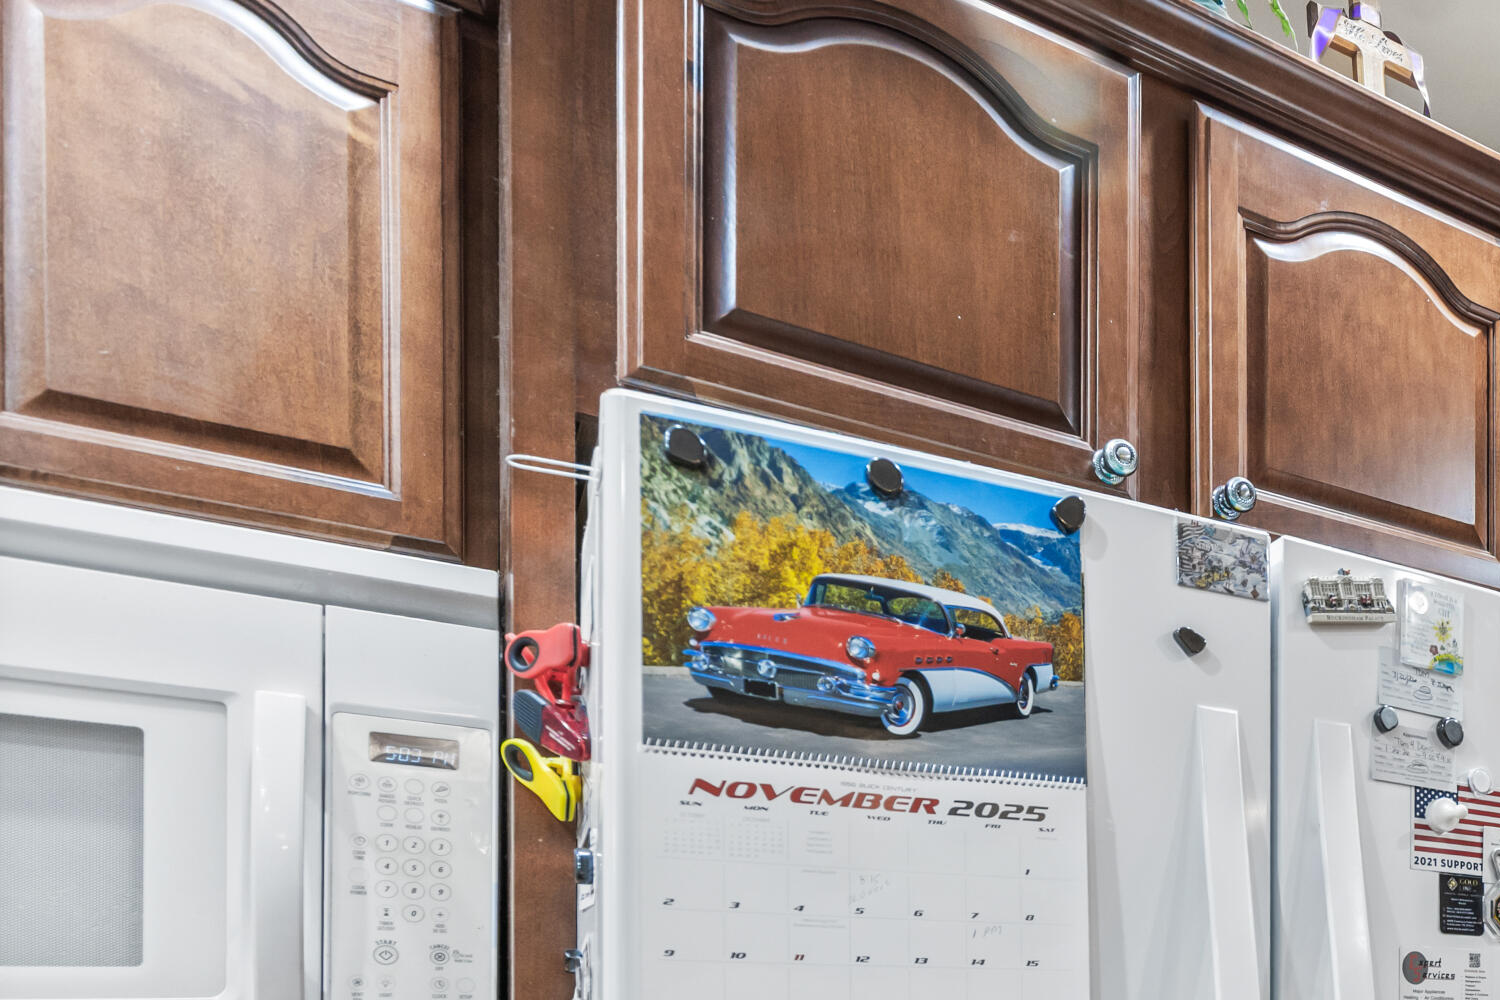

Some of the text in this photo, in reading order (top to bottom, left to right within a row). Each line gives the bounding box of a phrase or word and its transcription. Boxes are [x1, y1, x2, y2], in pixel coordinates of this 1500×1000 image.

[680, 799, 703, 807] SUN
[809, 809, 829, 817] TUE
[688, 778, 1049, 822] NOVEMBER 2025
[1025, 868, 1031, 876] 1
[1414, 856, 1483, 872] 2021 SUPPORT
[662, 898, 675, 906] 2
[728, 901, 741, 909] 3
[793, 904, 805, 912] 4
[854, 907, 865, 915] 5
[1025, 914, 1035, 922] 8
[663, 949, 675, 957] 9
[730, 952, 747, 960] 10
[855, 955, 870, 963] 12
[914, 957, 928, 965] 13
[971, 958, 985, 966] 14
[1412, 966, 1456, 982] Services
